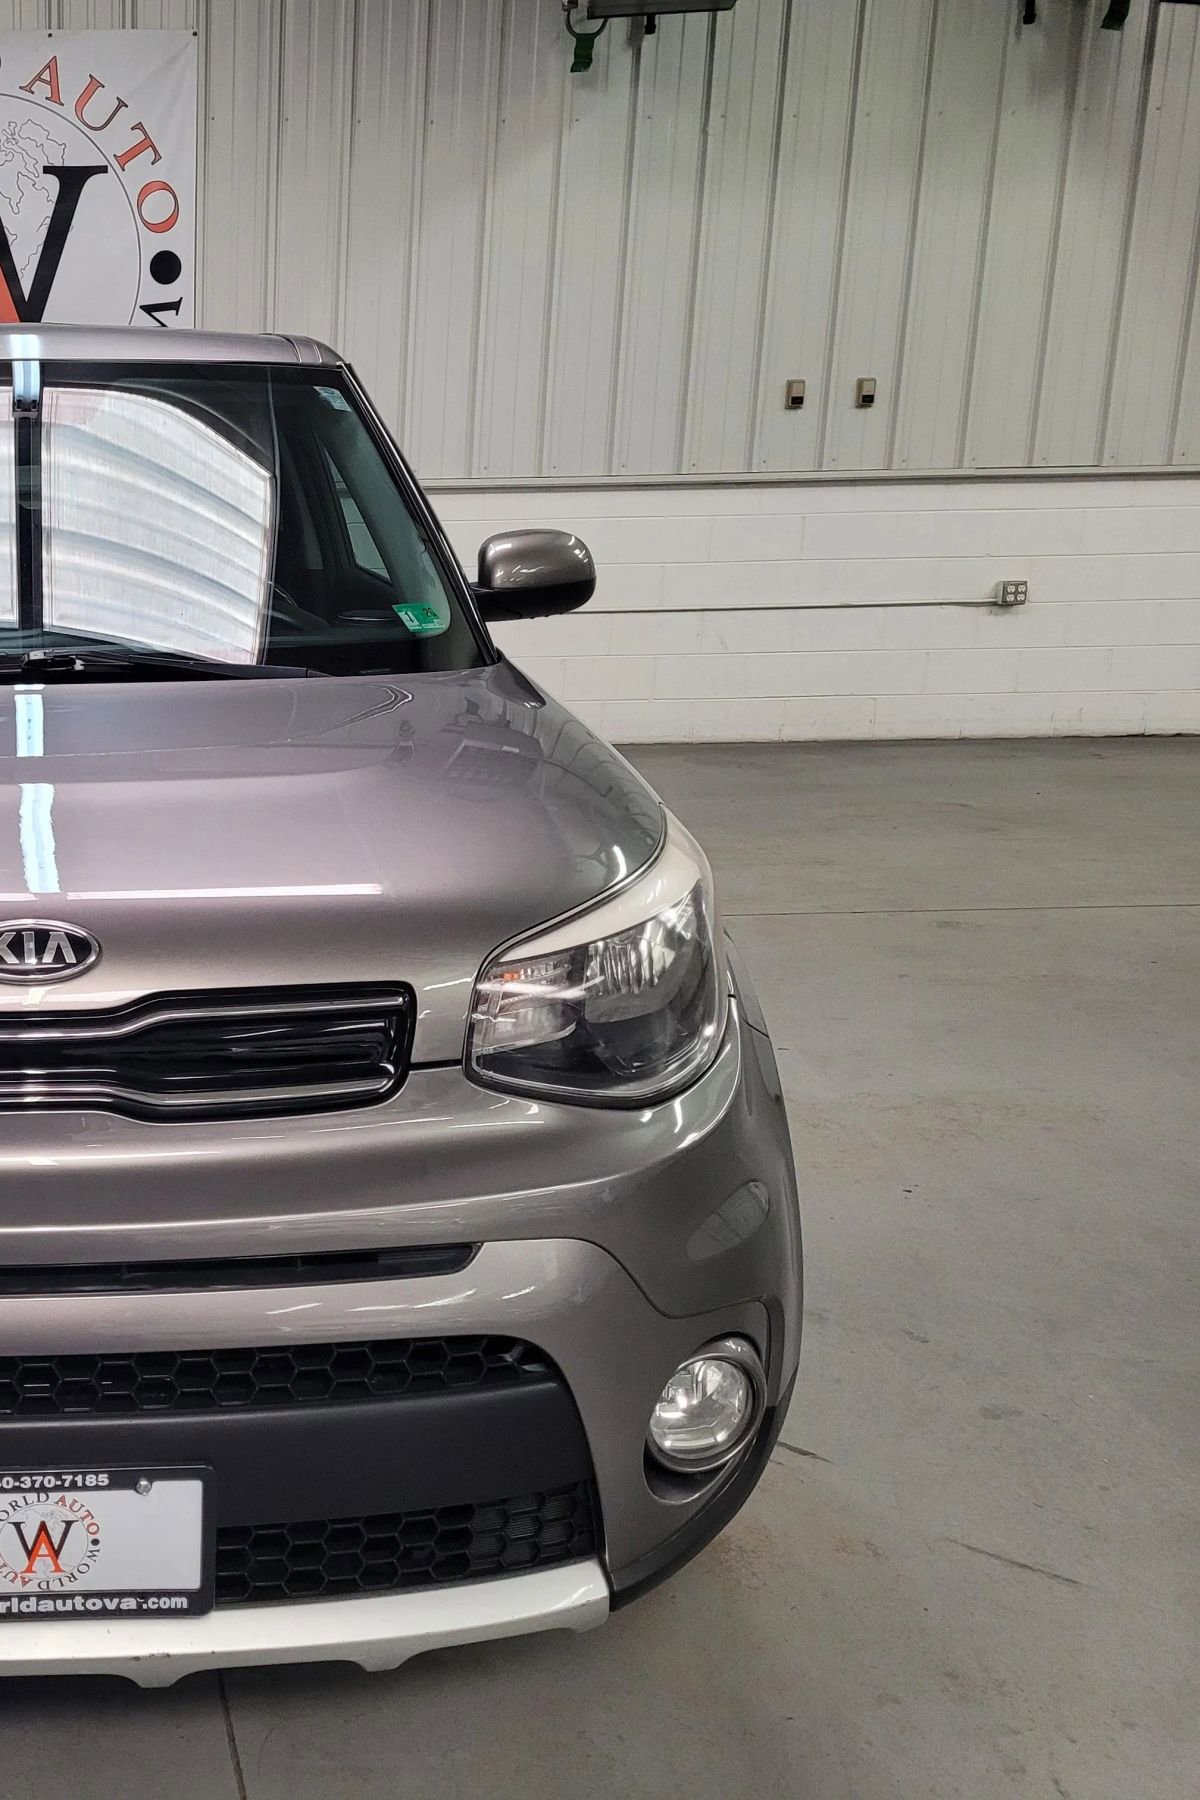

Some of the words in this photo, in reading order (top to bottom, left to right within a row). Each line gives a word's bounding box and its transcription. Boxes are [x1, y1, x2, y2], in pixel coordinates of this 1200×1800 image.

[19, 55, 179, 233] AUTO
[54, 1494, 100, 1536] AUTO
[38, 1548, 100, 1591] WORLD
